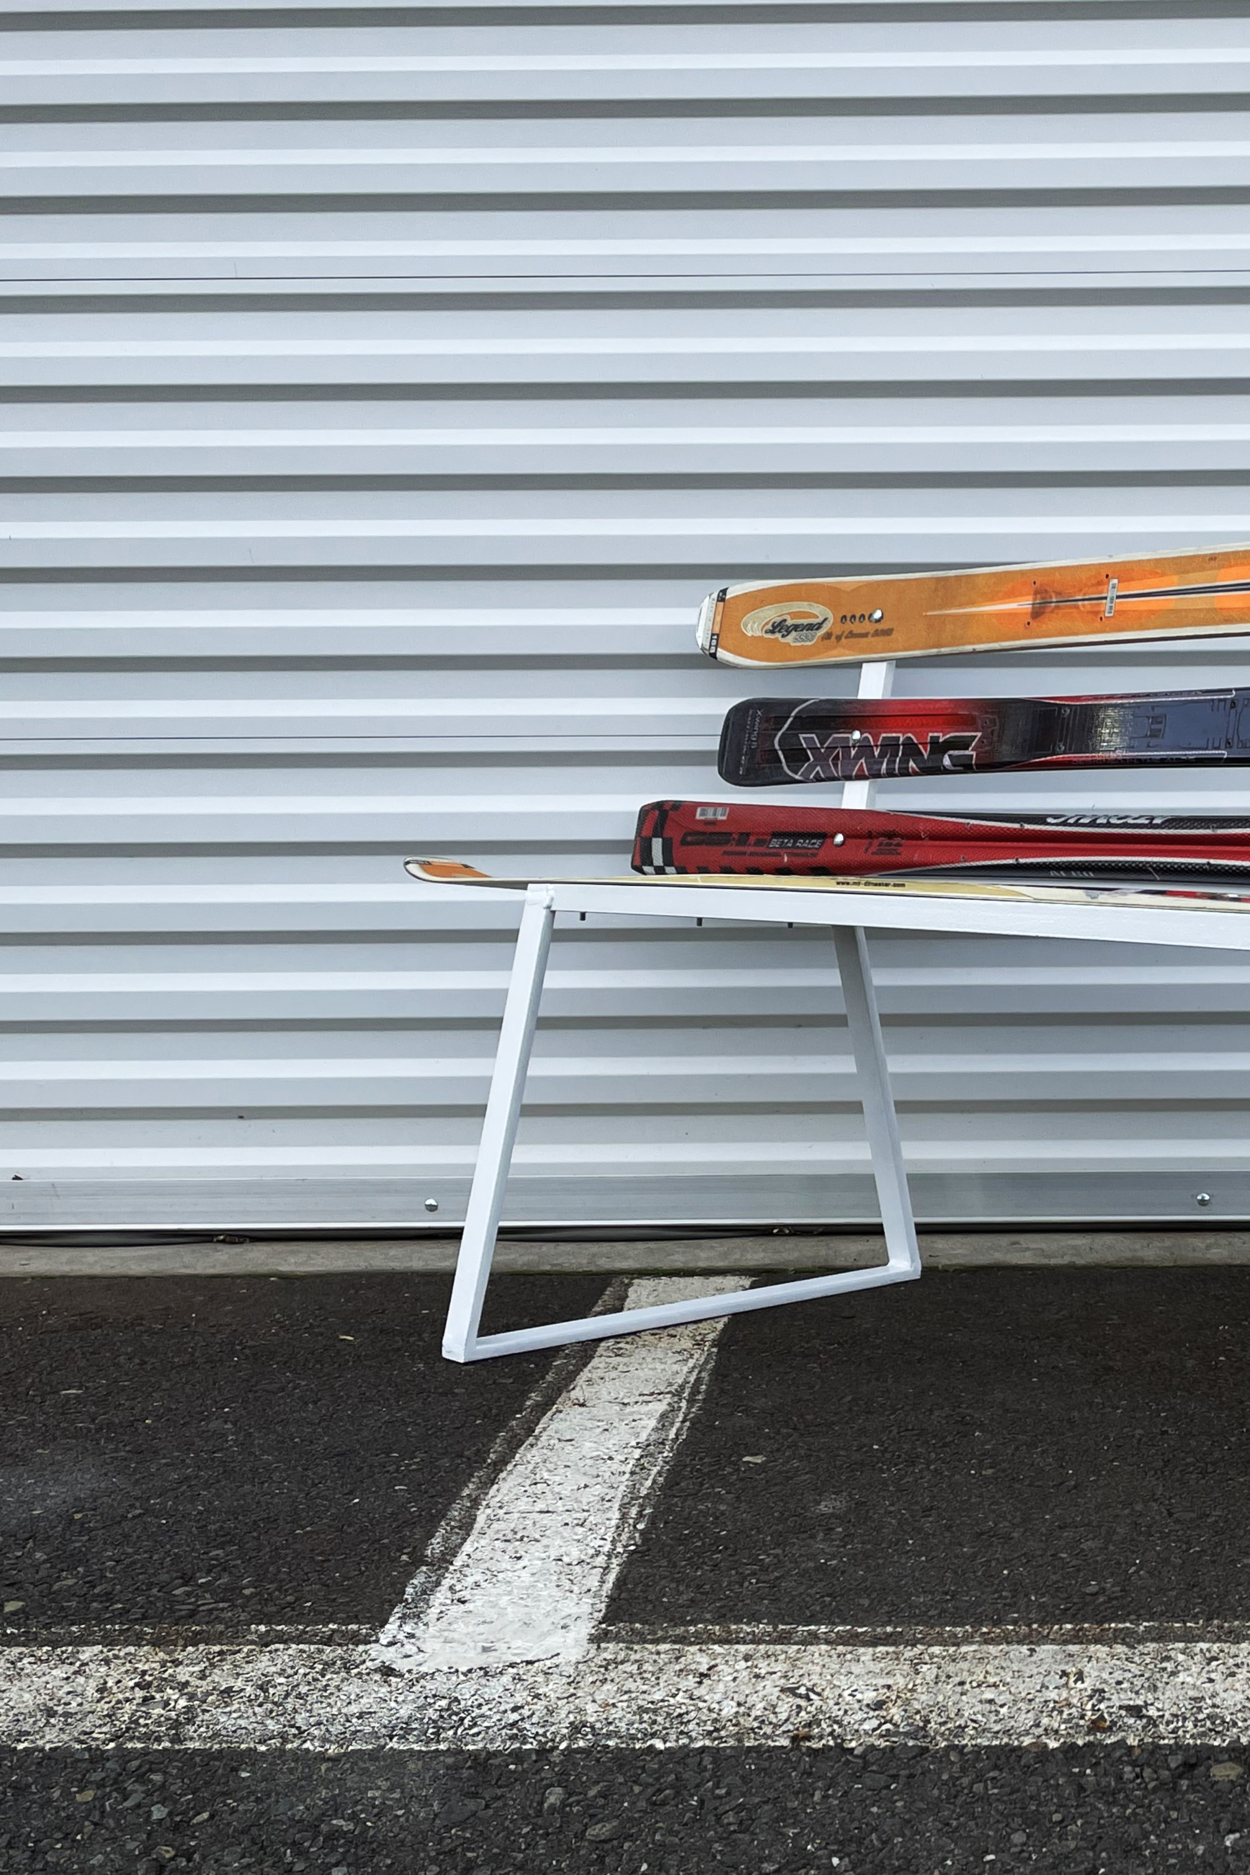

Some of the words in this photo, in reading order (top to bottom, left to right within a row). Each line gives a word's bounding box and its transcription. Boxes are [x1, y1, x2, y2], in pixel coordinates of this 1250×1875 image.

[765, 617, 829, 639] Legend
[797, 731, 983, 782] XWING
[767, 838, 793, 849] BETA
[795, 839, 823, 850] RACE
